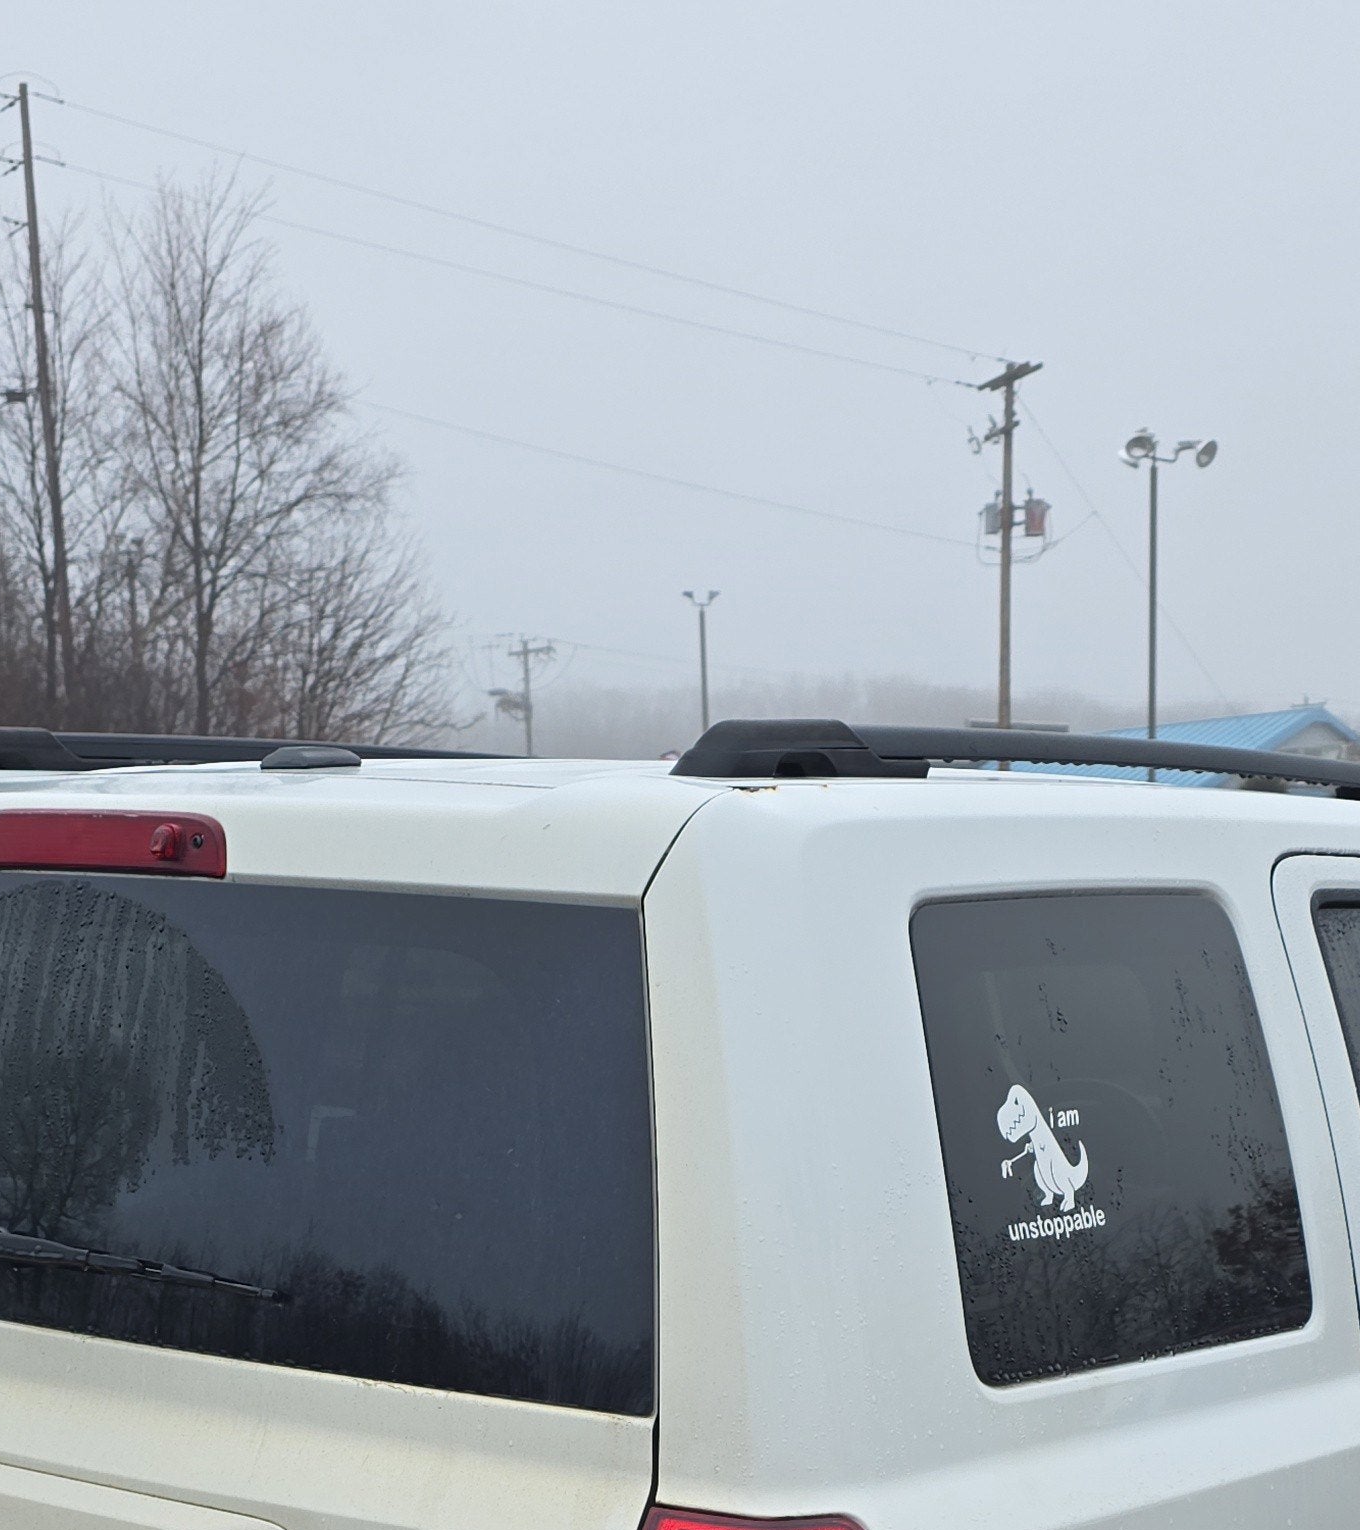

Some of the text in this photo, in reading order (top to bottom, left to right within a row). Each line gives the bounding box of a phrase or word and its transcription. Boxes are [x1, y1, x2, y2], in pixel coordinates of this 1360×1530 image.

[1048, 1107, 1080, 1129] i am
[1008, 1204, 1106, 1241] unstoppable
